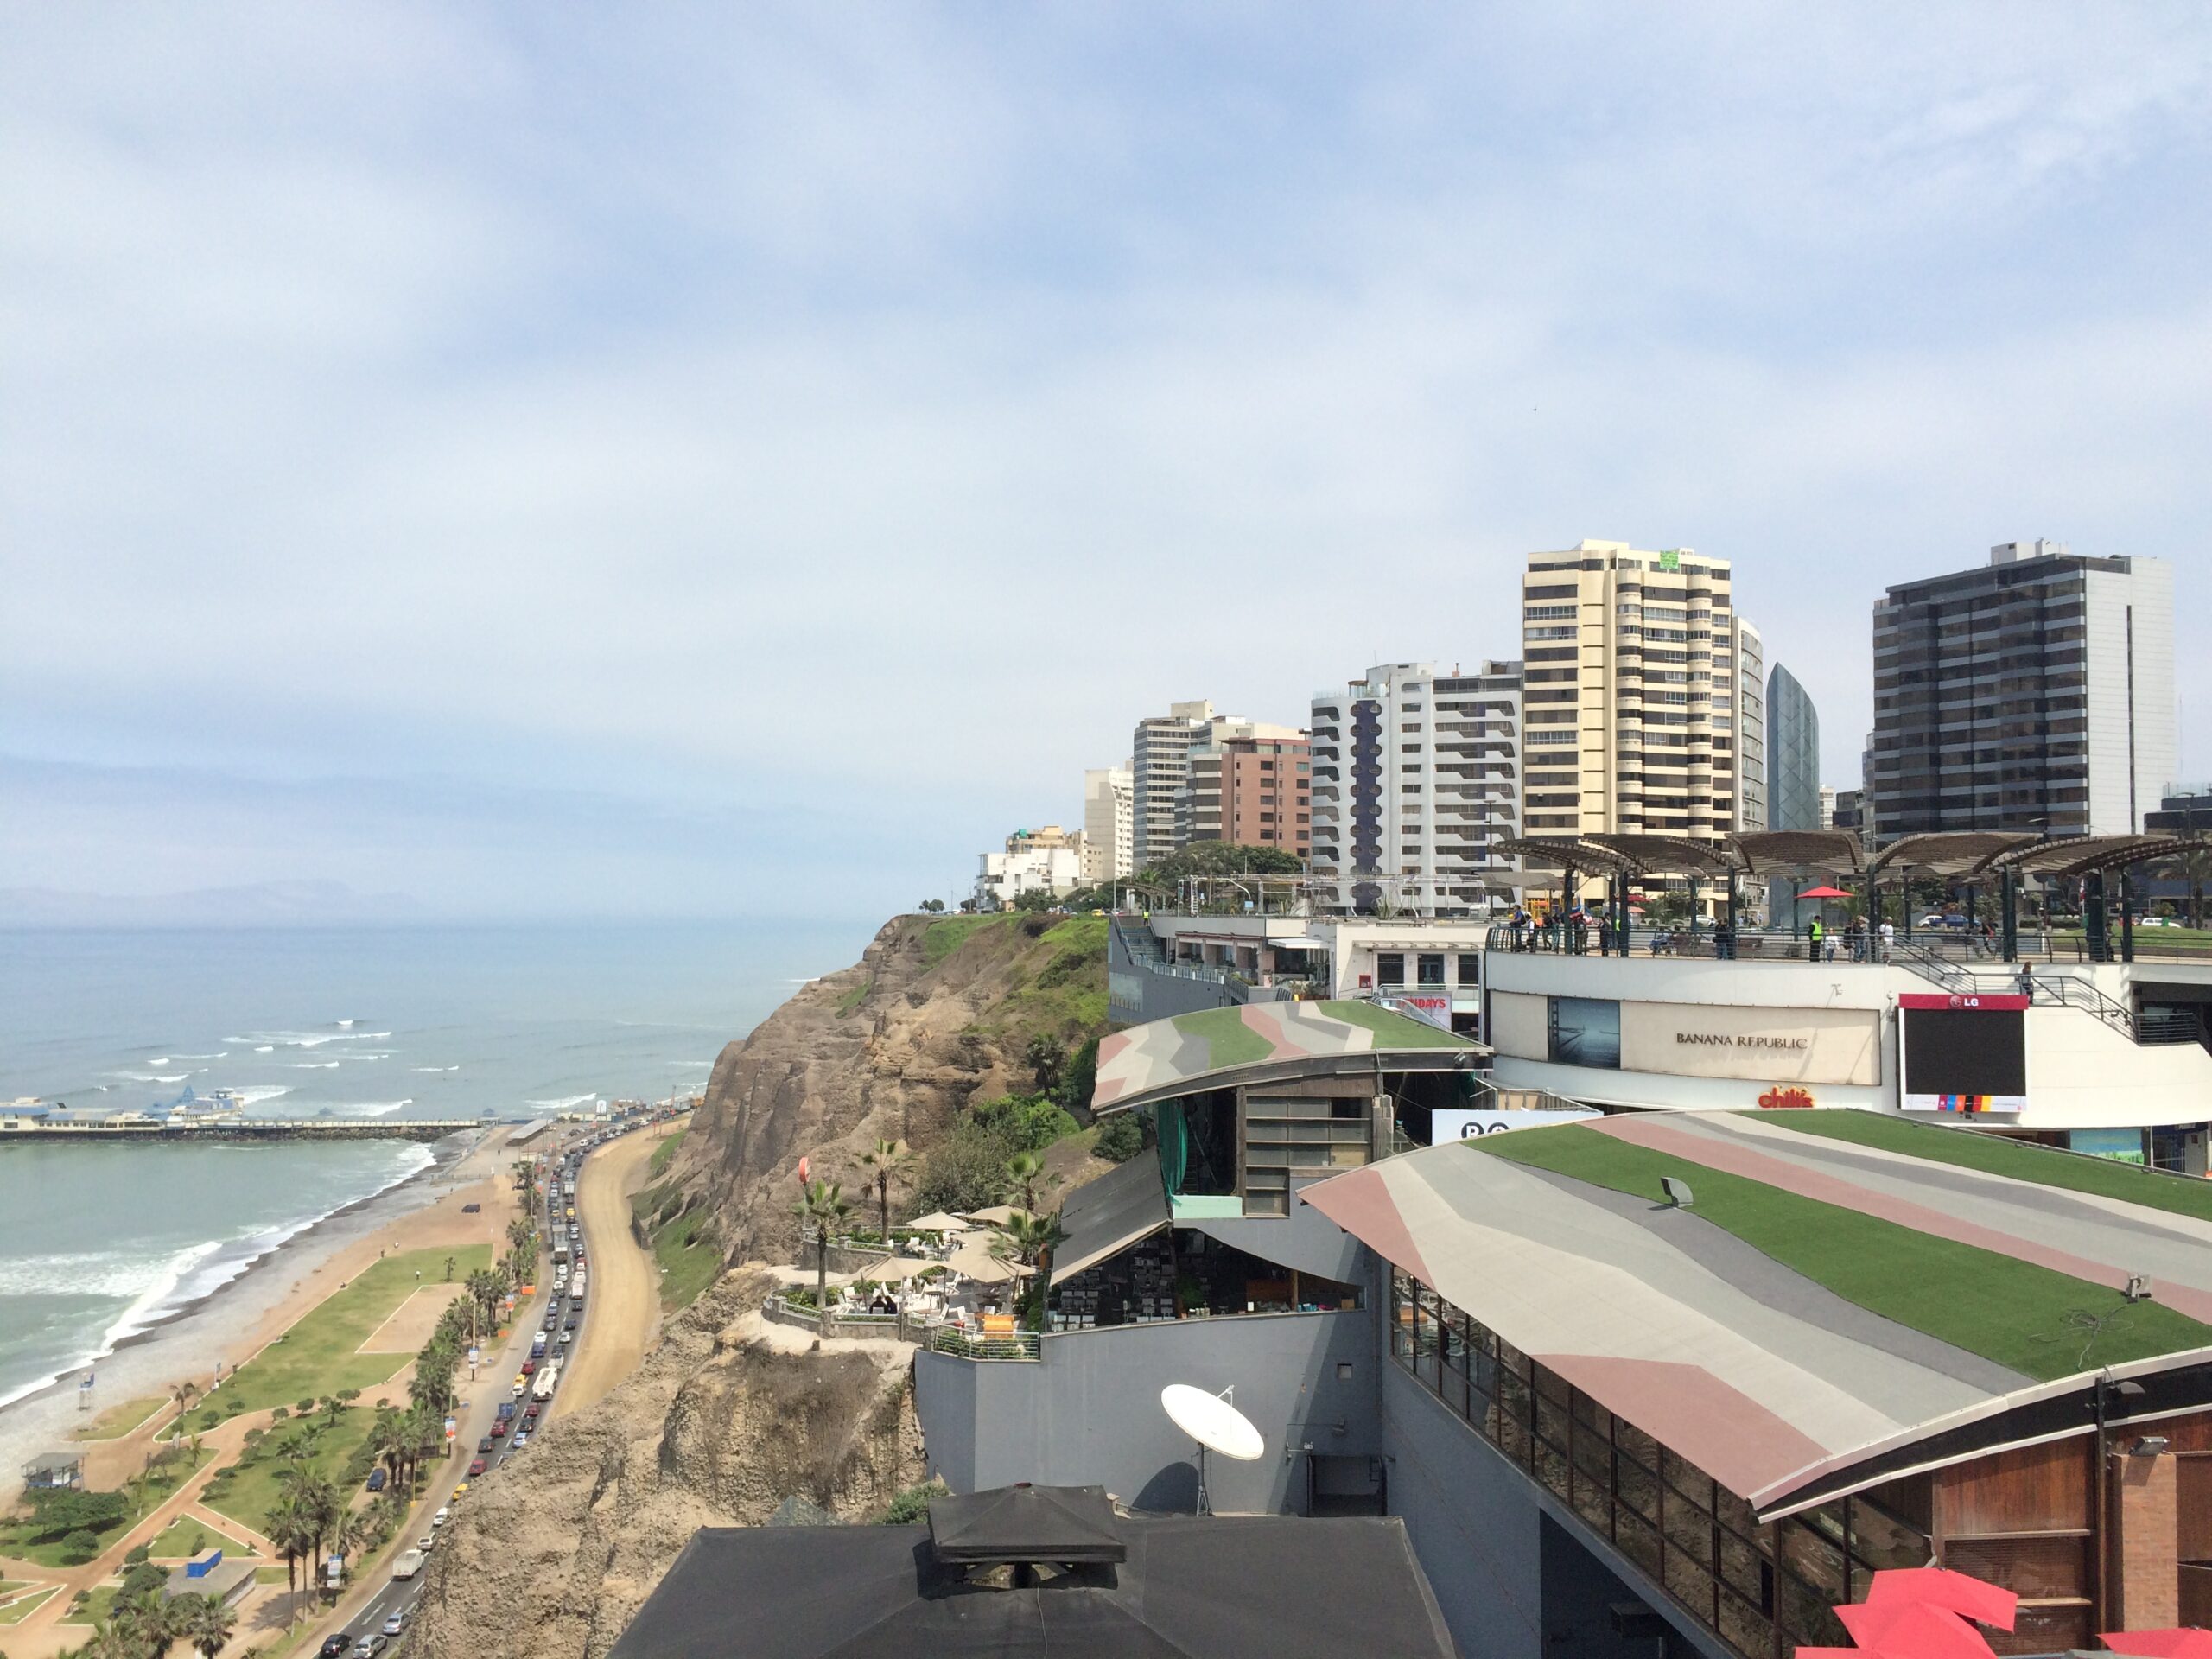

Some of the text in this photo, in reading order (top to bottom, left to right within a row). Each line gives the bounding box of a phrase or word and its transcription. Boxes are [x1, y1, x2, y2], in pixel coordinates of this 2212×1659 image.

[1963, 997, 1979, 1007] LG
[1676, 1033, 1808, 1049] BANANA REPUBLIC
